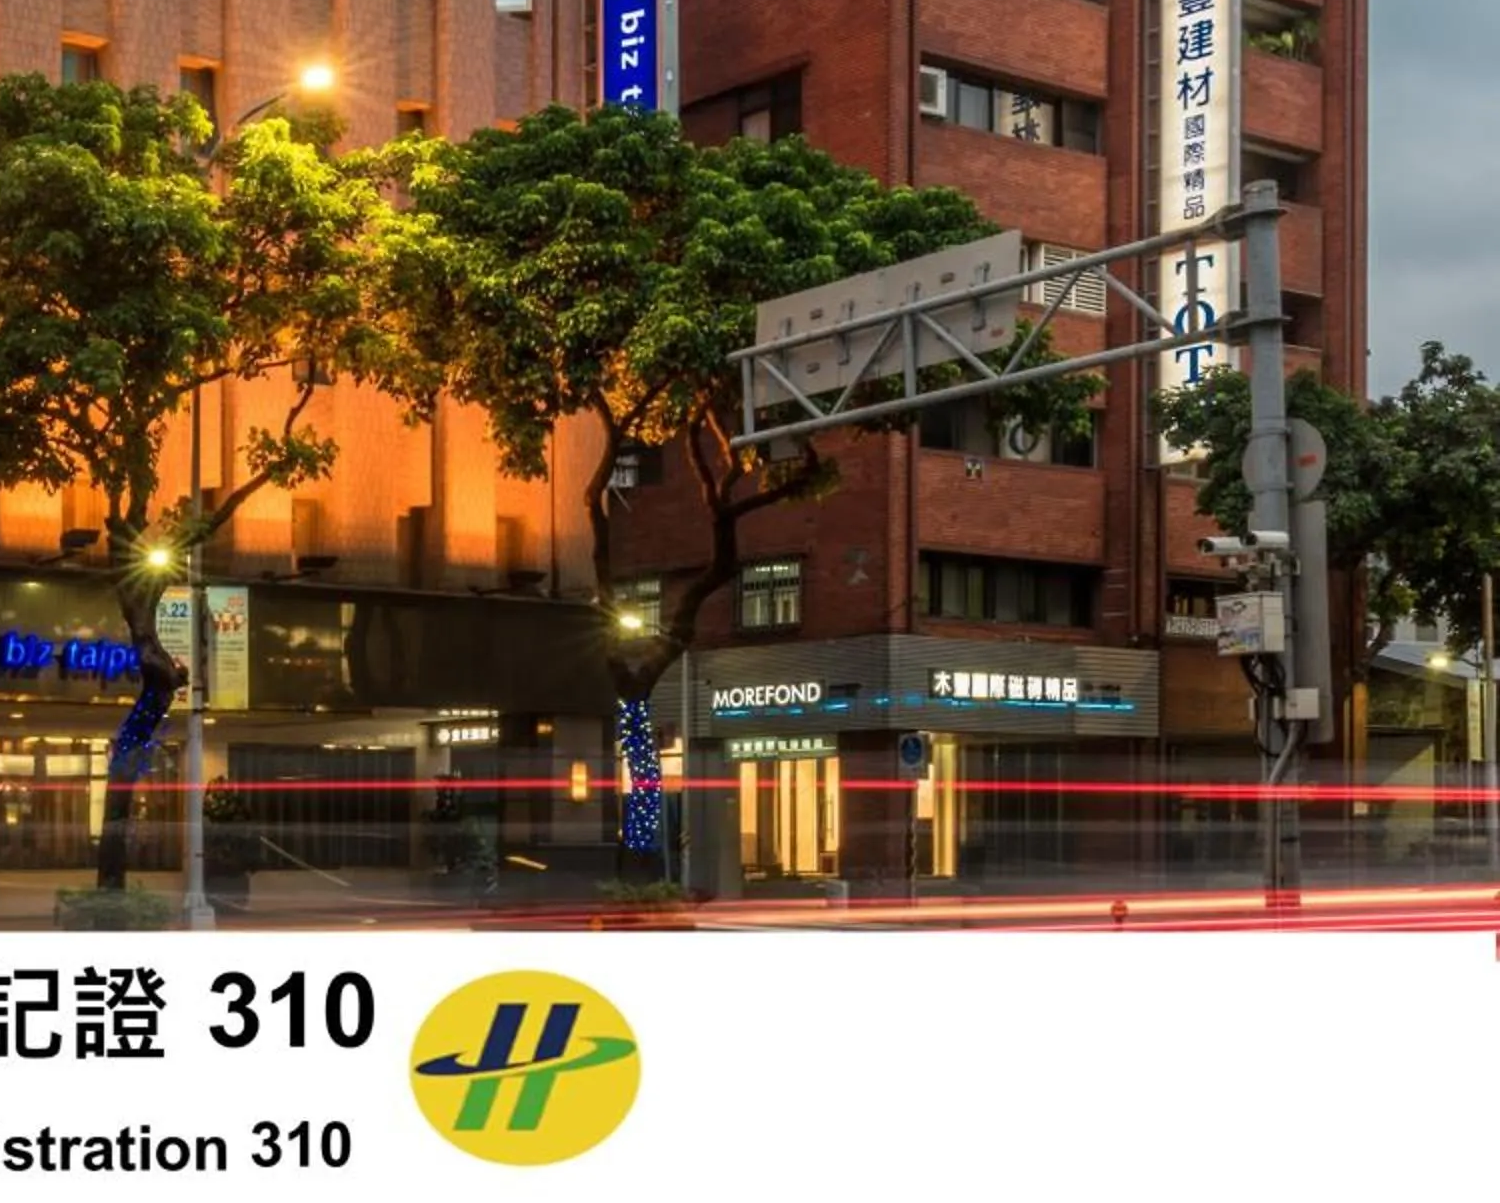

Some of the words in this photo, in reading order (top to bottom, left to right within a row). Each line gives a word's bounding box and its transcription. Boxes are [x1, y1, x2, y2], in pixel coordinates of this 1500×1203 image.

[620, 9, 646, 71] biz
[1173, 254, 1216, 385] TOT
[5, 631, 53, 667] biz
[67, 639, 142, 679] taip
[712, 682, 821, 709] MOREFOND
